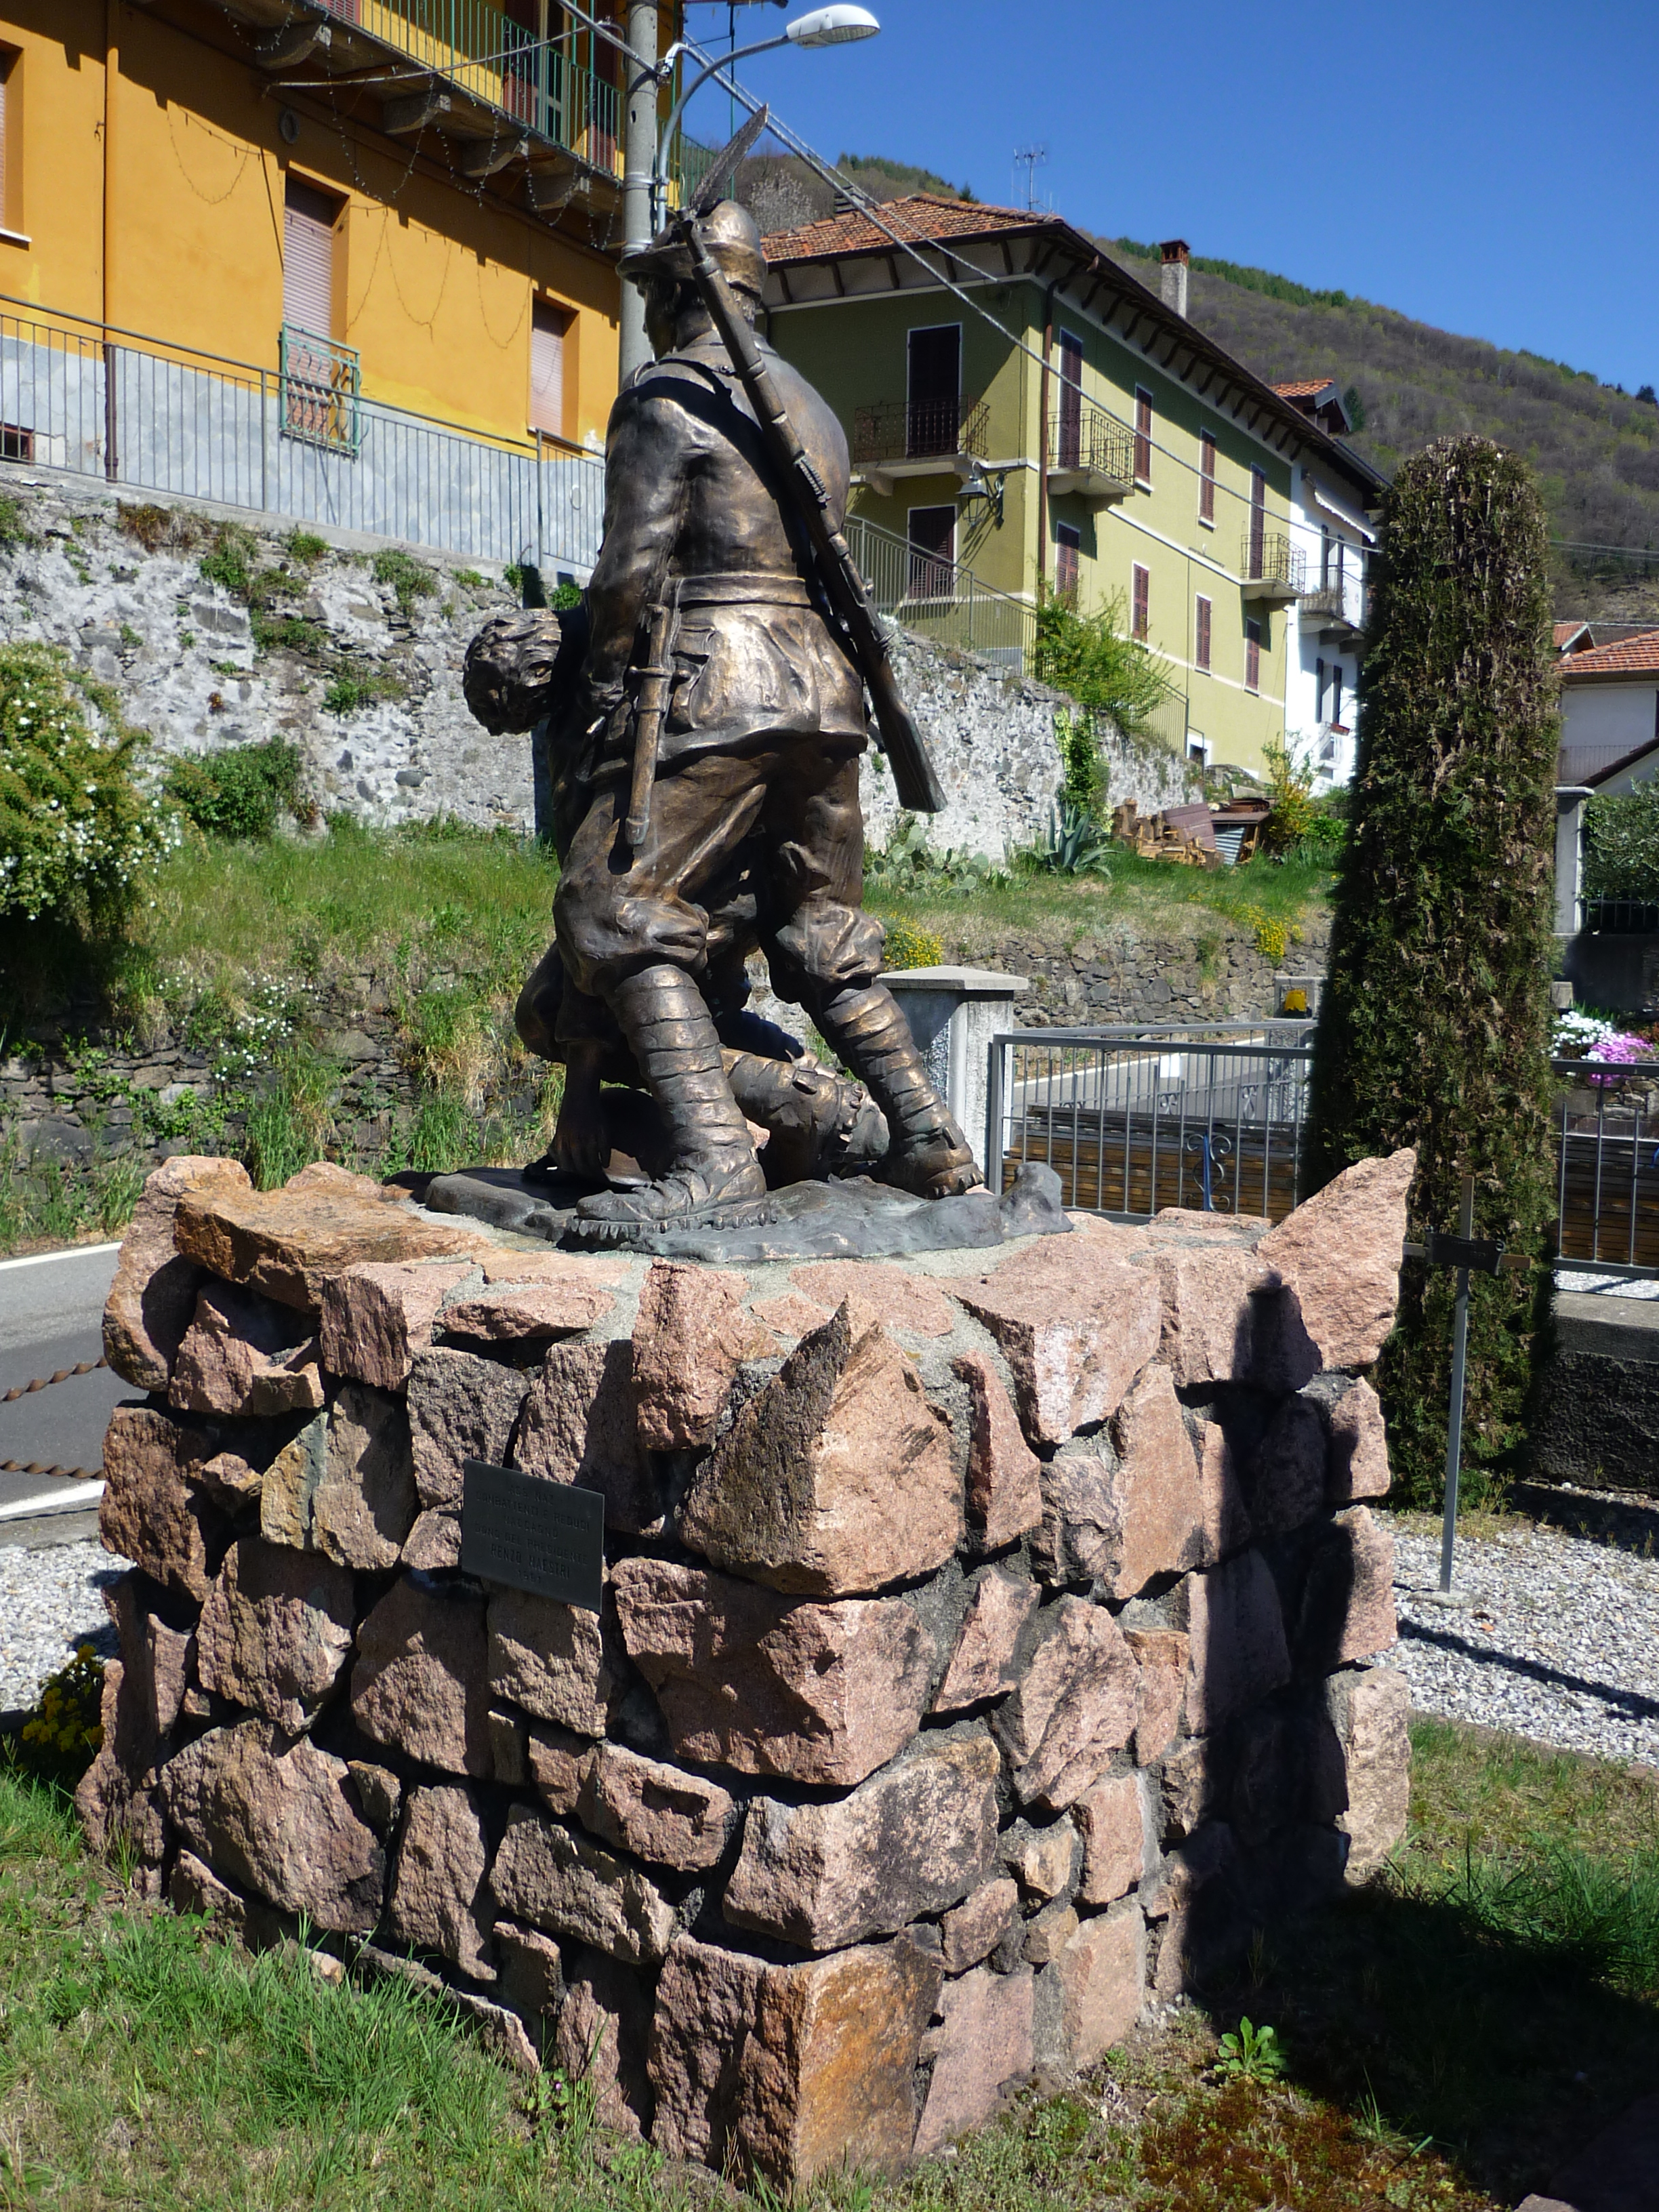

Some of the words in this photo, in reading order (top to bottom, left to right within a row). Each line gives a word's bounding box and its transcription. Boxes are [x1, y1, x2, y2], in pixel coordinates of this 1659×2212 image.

[476, 1491, 538, 1517] COMBATTENTI
[543, 1509, 548, 1519] E
[554, 1512, 589, 1532] REDUCI
[491, 1543, 521, 1564] RENZO
[529, 1555, 569, 1579] MAESTRI
[505, 1532, 521, 1545] DEL
[527, 1538, 588, 1565] PRESIDENTE
